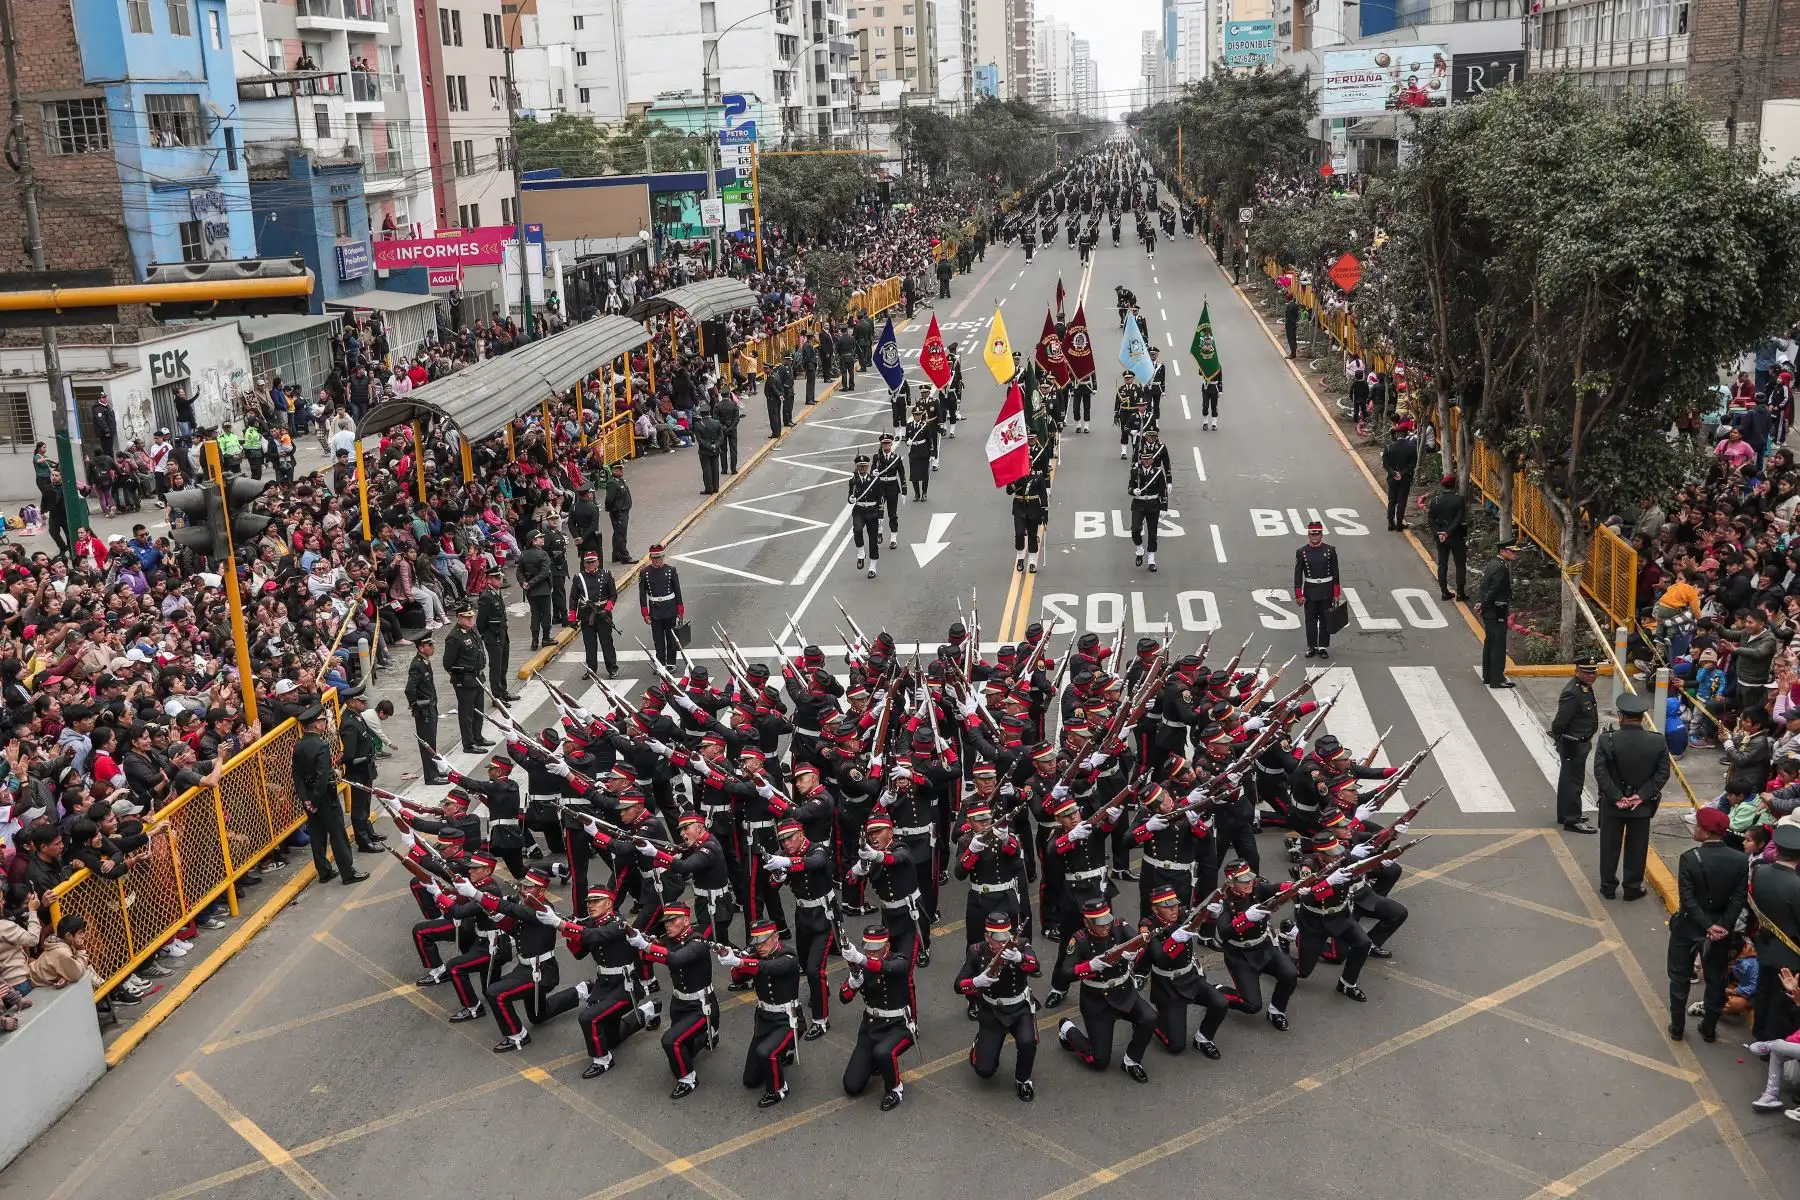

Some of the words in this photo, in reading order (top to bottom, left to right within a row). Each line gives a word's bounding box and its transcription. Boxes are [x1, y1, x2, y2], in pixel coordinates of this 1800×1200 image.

[1228, 40, 1272, 50] DISPONIBLE
[1327, 75, 1382, 84] PERUANA
[396, 243, 480, 260] INFORMES
[432, 273, 455, 284] AQUÍ
[1249, 508, 1370, 536] BUS
[1040, 589, 1222, 635] SOLO
[1250, 588, 1449, 629] SLO
